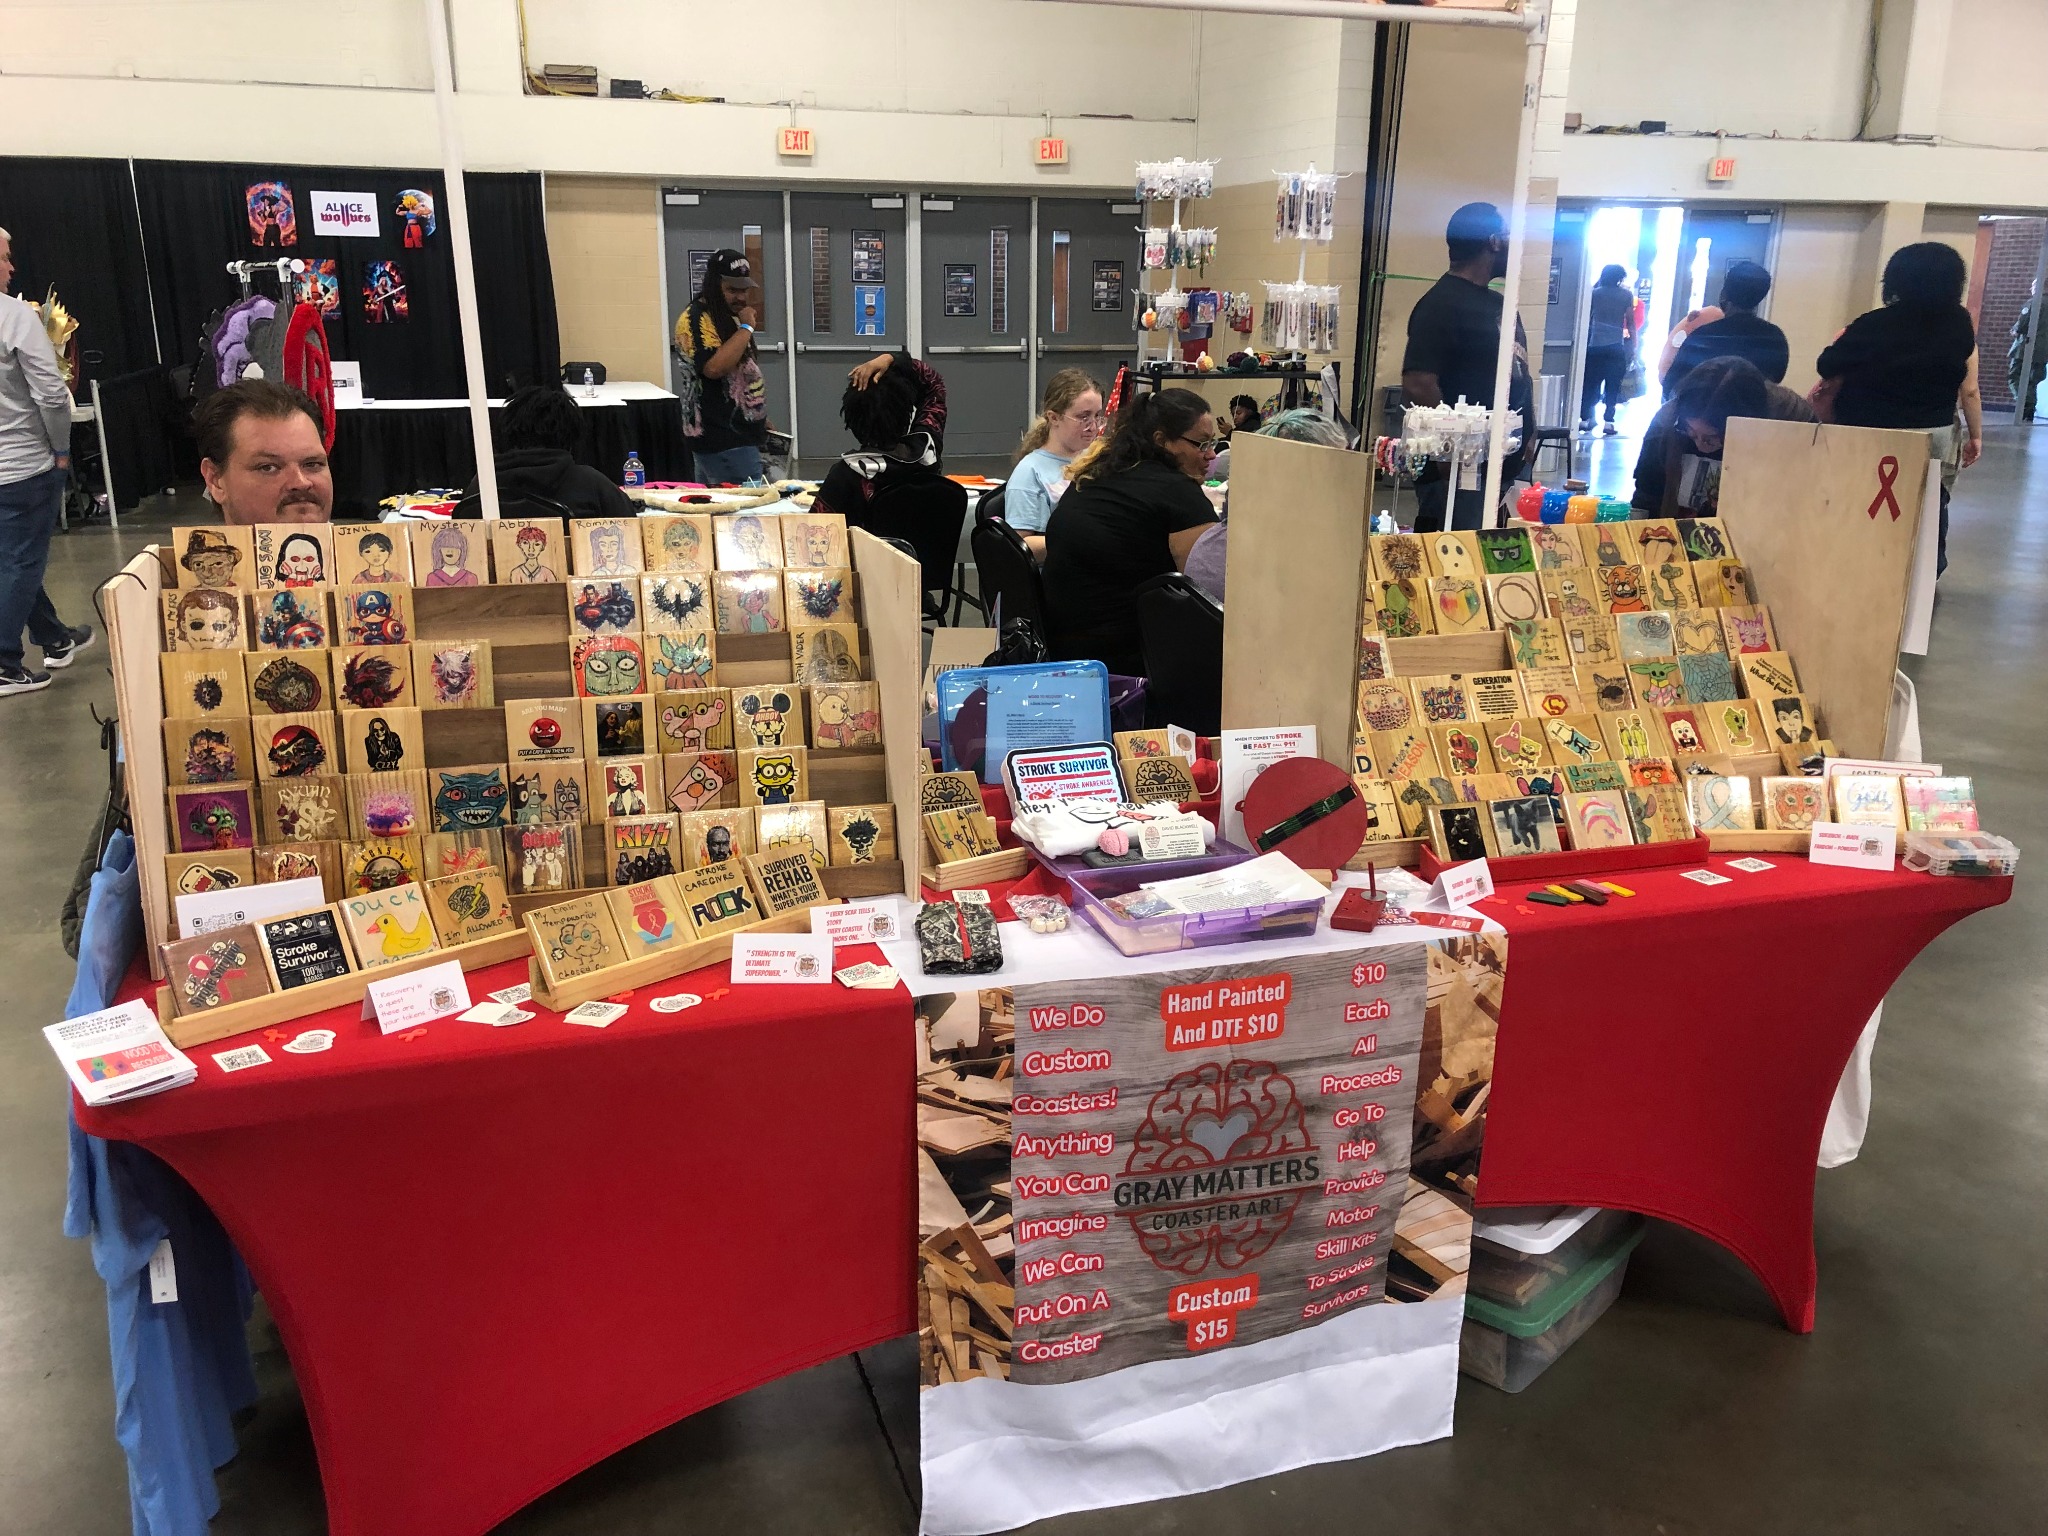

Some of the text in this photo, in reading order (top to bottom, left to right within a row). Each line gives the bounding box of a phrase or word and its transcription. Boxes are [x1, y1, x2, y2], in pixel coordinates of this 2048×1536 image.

[784, 130, 810, 151] EXIT
[1040, 139, 1064, 160] EXIT
[1715, 159, 1735, 177] EXIT
[338, 526, 371, 536] JINU
[420, 521, 476, 532] Mystery
[498, 519, 534, 530] Abby
[258, 529, 274, 562] SAW
[718, 594, 730, 634] POPPY
[795, 631, 806, 662] VADER
[1473, 675, 1512, 685] GENERATION
[521, 705, 568, 716] ARE YOU MAD?
[1018, 758, 1109, 777] STROKE SURVIVOR
[1081, 778, 1114, 788] AWARENESS
[1135, 783, 1191, 794] GRAY MATTERS
[615, 823, 672, 848] KISS
[695, 863, 728, 876] STROKE
[758, 853, 807, 877] I SURVIVED
[627, 883, 653, 898] STROKE
[763, 865, 814, 894] REHAB
[350, 889, 420, 916] DUCK
[770, 881, 818, 904] WHAT'S YOUR
[774, 891, 821, 912] SUPER POWER?
[533, 912, 547, 920] My
[691, 885, 753, 928] ROCK
[466, 920, 504, 935] ALLOWED
[841, 925, 863, 933] COASTER
[276, 941, 318, 959] Stroke
[278, 950, 329, 970] Survivor
[302, 964, 322, 977] 100%
[1353, 964, 1385, 986] $10
[380, 985, 415, 998] Recovery
[1167, 980, 1285, 1014] Hand Painted
[381, 1004, 415, 1017] these are
[385, 998, 404, 1008] quest
[1346, 1000, 1389, 1021] Each
[383, 1011, 426, 1029] your tokens
[1031, 1005, 1104, 1030] We Do
[1172, 1012, 1278, 1045] And DTF $10
[121, 1046, 149, 1059] WOOD
[1354, 1035, 1376, 1056] All
[1025, 1050, 1109, 1074] Custom
[1322, 1066, 1401, 1093] Proceeds
[1014, 1088, 1117, 1113] Coasters!
[1335, 1104, 1385, 1127] Go To
[1015, 1132, 1113, 1157] Anything
[1338, 1139, 1376, 1161] Help
[1017, 1173, 1108, 1197] You Can
[1113, 1156, 1320, 1208] GRAY MATTERS
[1325, 1170, 1385, 1195] Provide
[1152, 1196, 1283, 1231] COASTER ART
[1327, 1205, 1379, 1227] Motor
[1021, 1213, 1106, 1240] Imagine
[1316, 1231, 1378, 1260] Skill Kits
[1024, 1253, 1102, 1283] We Can
[1308, 1255, 1375, 1290] To Stroke
[1017, 1290, 1109, 1325] Put On A
[1176, 1286, 1251, 1313] Custom
[1303, 1284, 1369, 1318] Survivors
[1194, 1318, 1229, 1345] $15
[1021, 1334, 1102, 1361] Coaster
